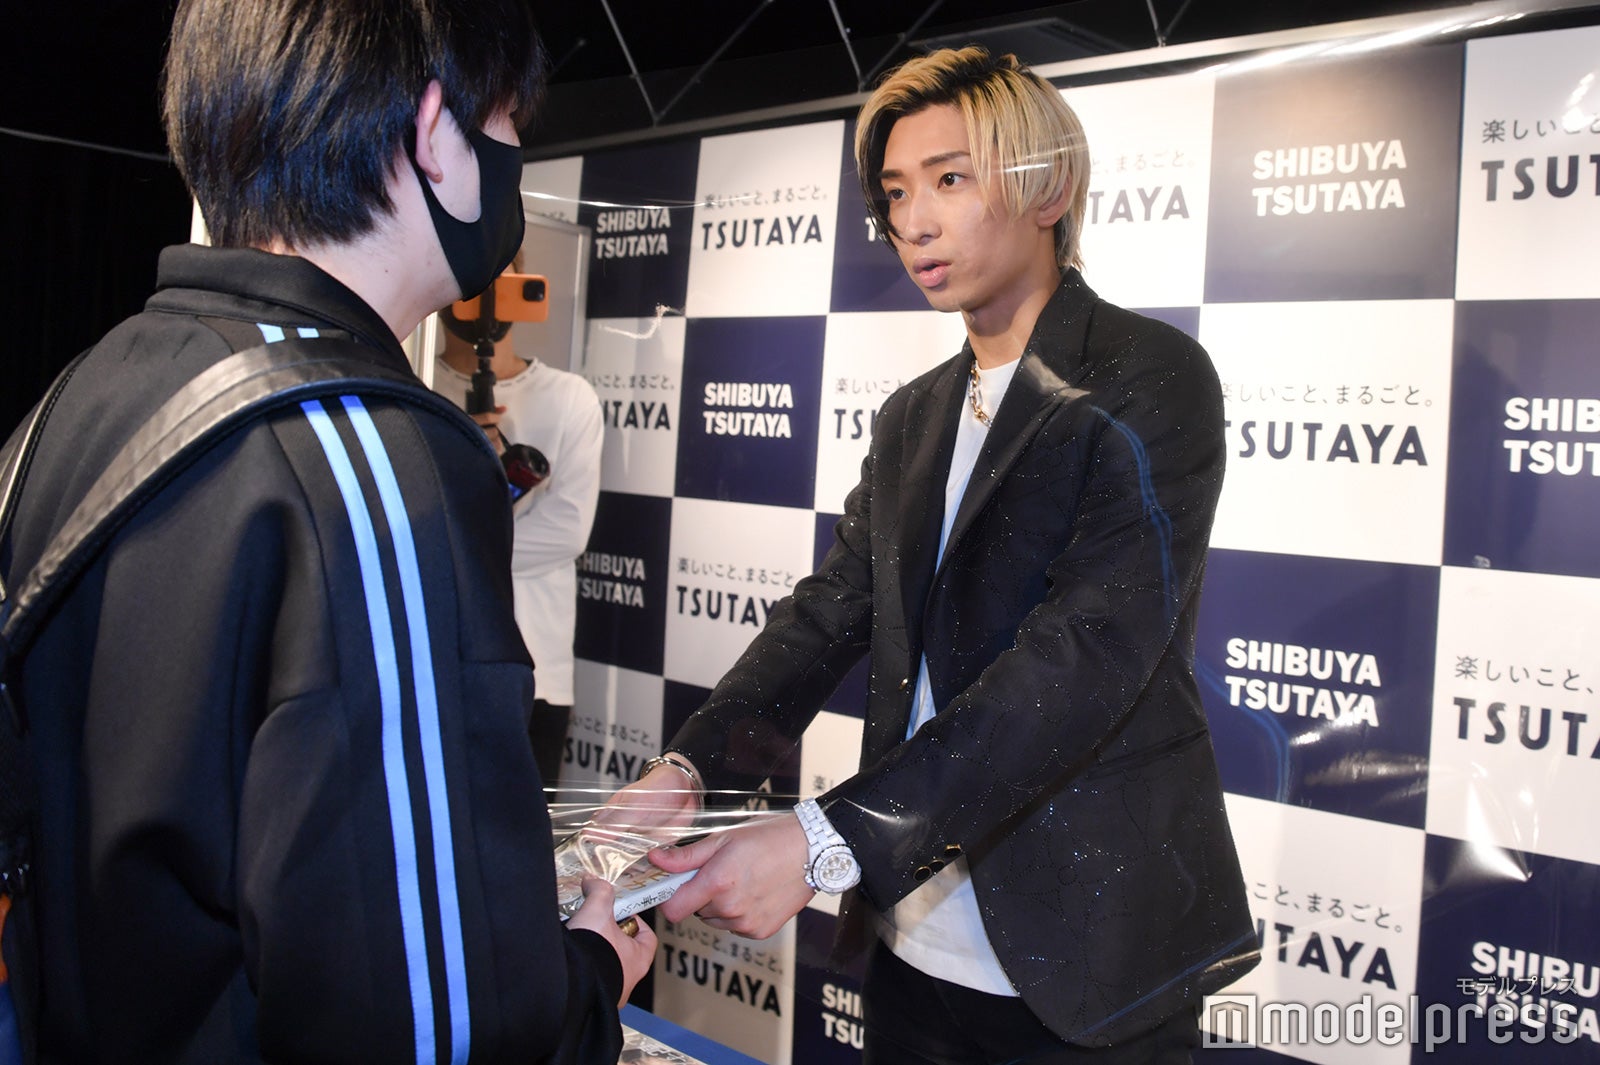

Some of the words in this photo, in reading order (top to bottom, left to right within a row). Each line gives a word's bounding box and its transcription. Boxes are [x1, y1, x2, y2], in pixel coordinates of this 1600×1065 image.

[1252, 139, 1406, 180] SHIBUYA
[1088, 185, 1190, 225] TAYA
[1252, 178, 1406, 217] TSUTAYA
[596, 206, 671, 234] SHIBUYA
[702, 214, 822, 251] TSUTAYA
[595, 233, 669, 259] TSUTAYA
[704, 382, 793, 409] SHIBUYA
[1503, 397, 1600, 432] SHIB
[703, 411, 792, 438] TSUTAYA
[1225, 637, 1381, 687] SHIBUYA
[1225, 676, 1379, 727] TSUTAYA
[564, 737, 646, 781] SUTAY
[662, 943, 782, 1017] TSUTAYA
[821, 985, 864, 1020] SHI
